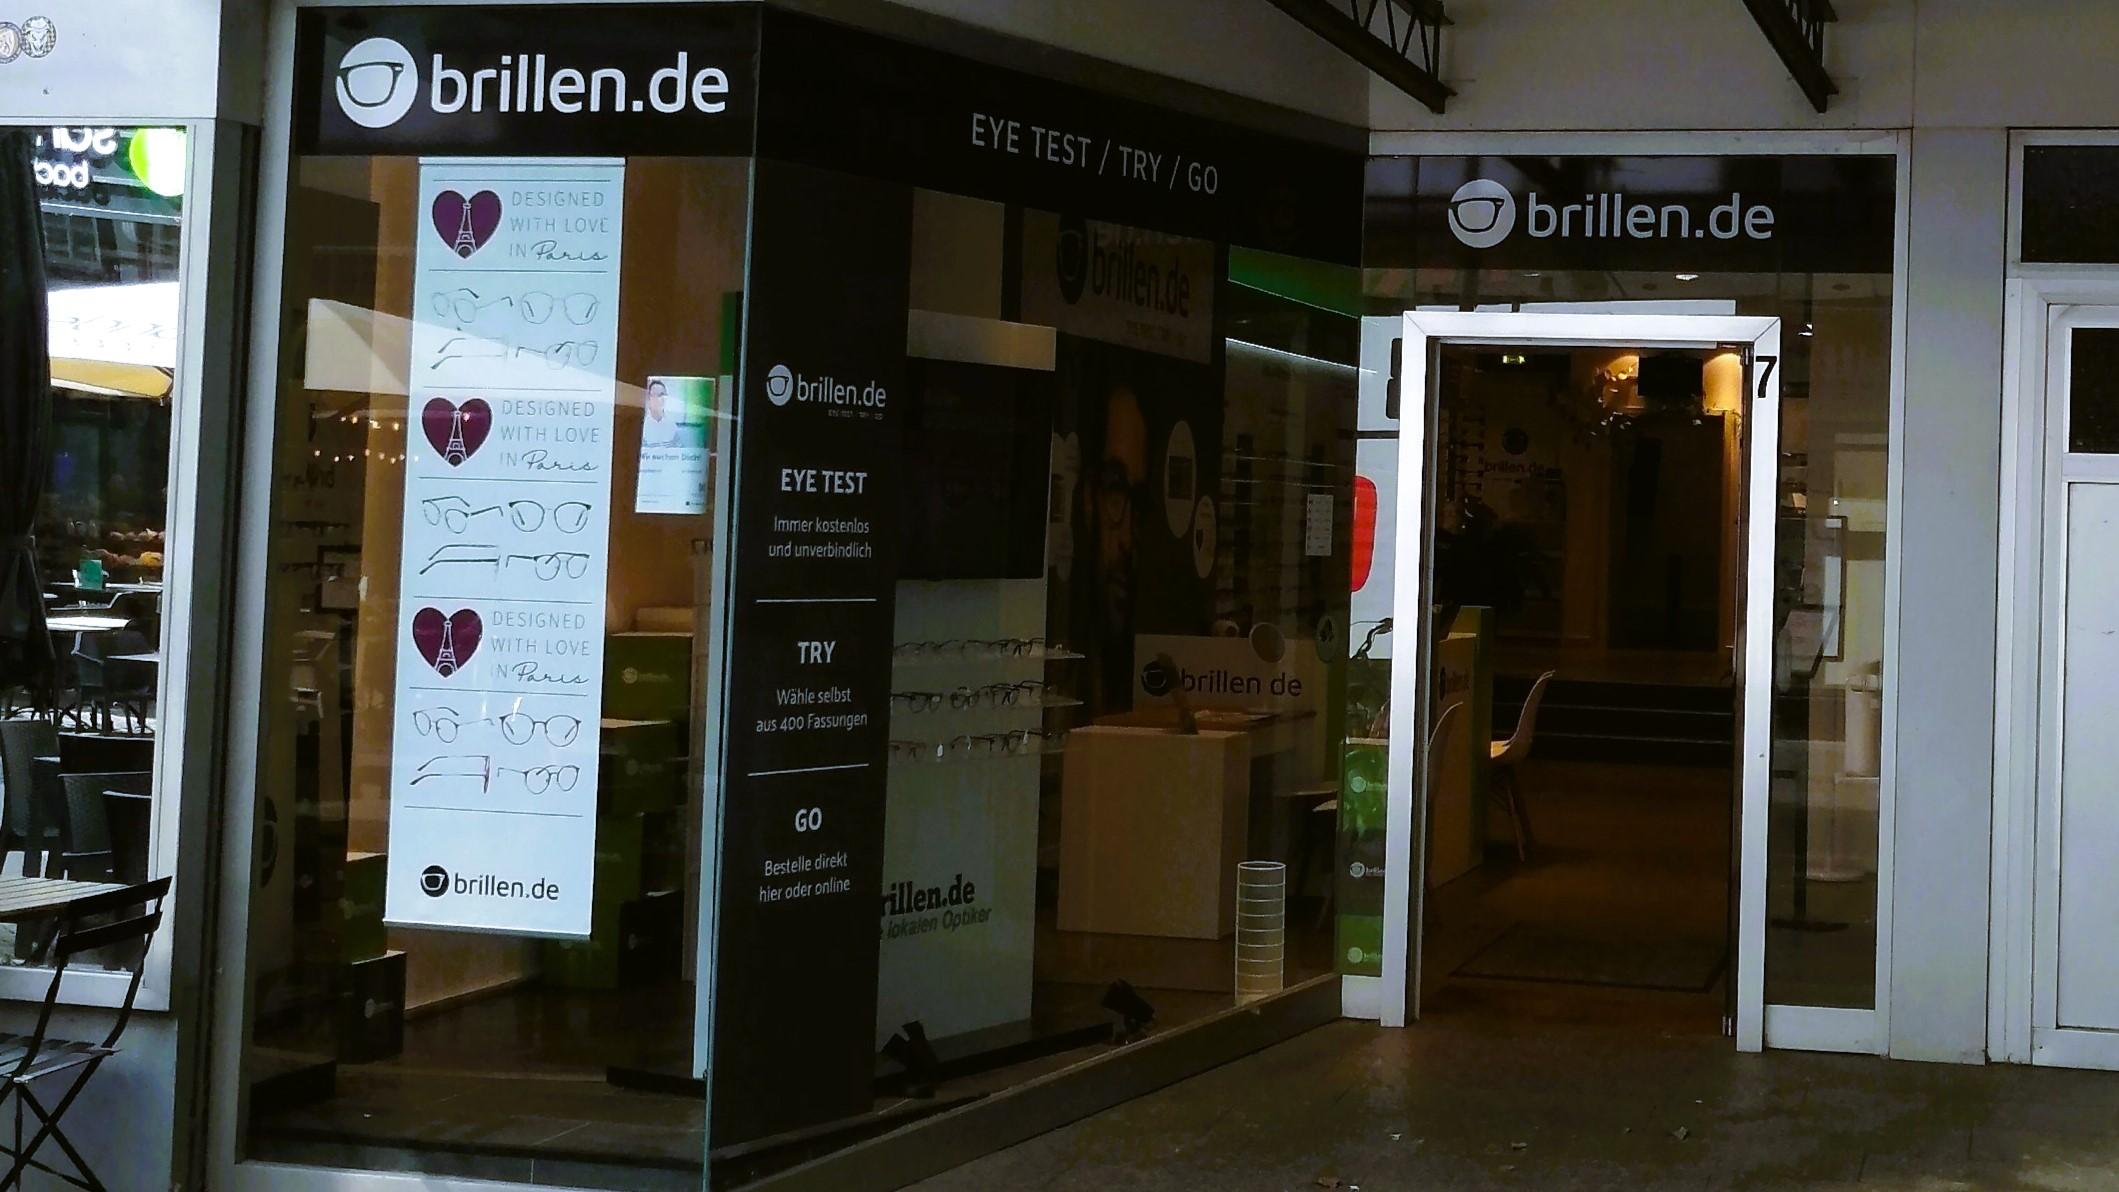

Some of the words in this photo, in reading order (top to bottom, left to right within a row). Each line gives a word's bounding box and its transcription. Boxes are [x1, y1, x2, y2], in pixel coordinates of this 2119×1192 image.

[430, 51, 730, 114] brillen.de
[971, 112, 1021, 154] EYE
[1031, 126, 1092, 168] TEST
[1118, 145, 1162, 183] TRY
[1188, 162, 1218, 194] GO
[511, 191, 605, 207] DESIGNED
[509, 217, 556, 233] WITH
[565, 218, 609, 233] LOVE
[1527, 191, 1775, 239] brillen.de
[508, 244, 527, 258] IN
[530, 240, 609, 262] Paris
[1755, 356, 1777, 399] 7
[796, 373, 887, 408] brillen.de
[501, 400, 596, 417] DESIGNED
[501, 426, 547, 442] WITH
[555, 427, 600, 443] LOVE
[500, 452, 518, 467] IN
[521, 449, 599, 472] Paris
[781, 468, 817, 492] EYE
[822, 470, 868, 495] TEST
[773, 515, 814, 533] Immer
[815, 516, 870, 535] kostenlos
[768, 541, 791, 558] und
[795, 541, 872, 559] unverbindlich
[492, 610, 586, 630] DESIGNED
[491, 636, 538, 654] WITH
[545, 639, 590, 656] LOVE
[798, 640, 836, 664] TRY
[511, 661, 589, 685] Paris
[776, 687, 816, 706] Wähle
[817, 687, 852, 704] selbst
[755, 718, 778, 733] aus
[779, 715, 804, 732] 400
[807, 712, 867, 731] Fassungen
[794, 806, 822, 832] GO
[764, 858, 812, 877] Bestelle
[814, 850, 848, 870] direkt
[454, 873, 560, 900] brillen.de
[759, 884, 784, 903] hier
[785, 879, 813, 900] oder
[814, 875, 850, 896] online
[881, 873, 976, 916] rillen.de
